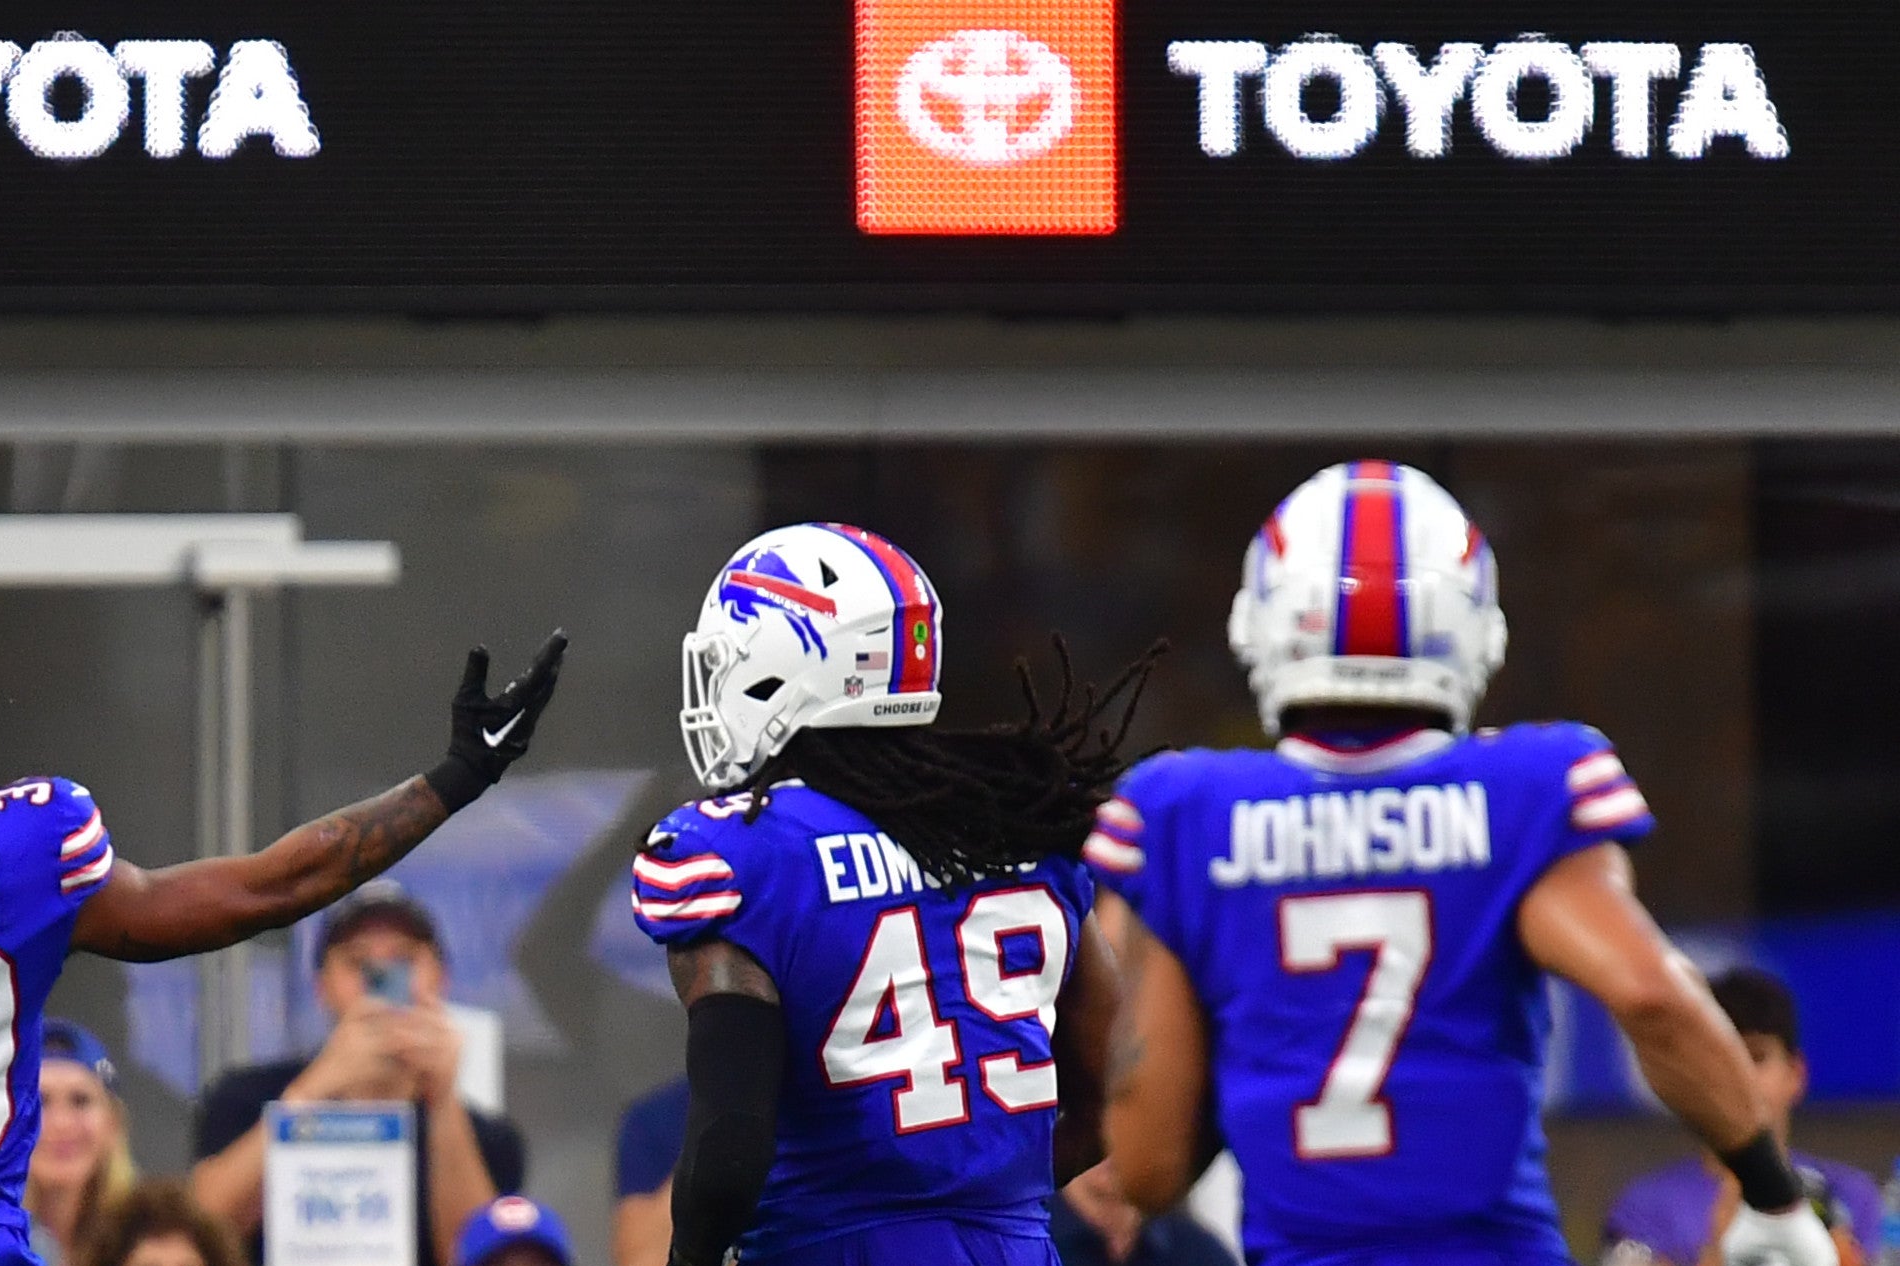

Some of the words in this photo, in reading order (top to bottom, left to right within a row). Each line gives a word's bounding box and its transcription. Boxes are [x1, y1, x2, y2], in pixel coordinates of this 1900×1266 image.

[1167, 32, 1790, 160] TOYOTA
[873, 701, 922, 717] CHOOSE
[1209, 780, 1492, 886] JOHNSON
[819, 884, 1068, 1135] 49
[1278, 888, 1434, 1161] 7
